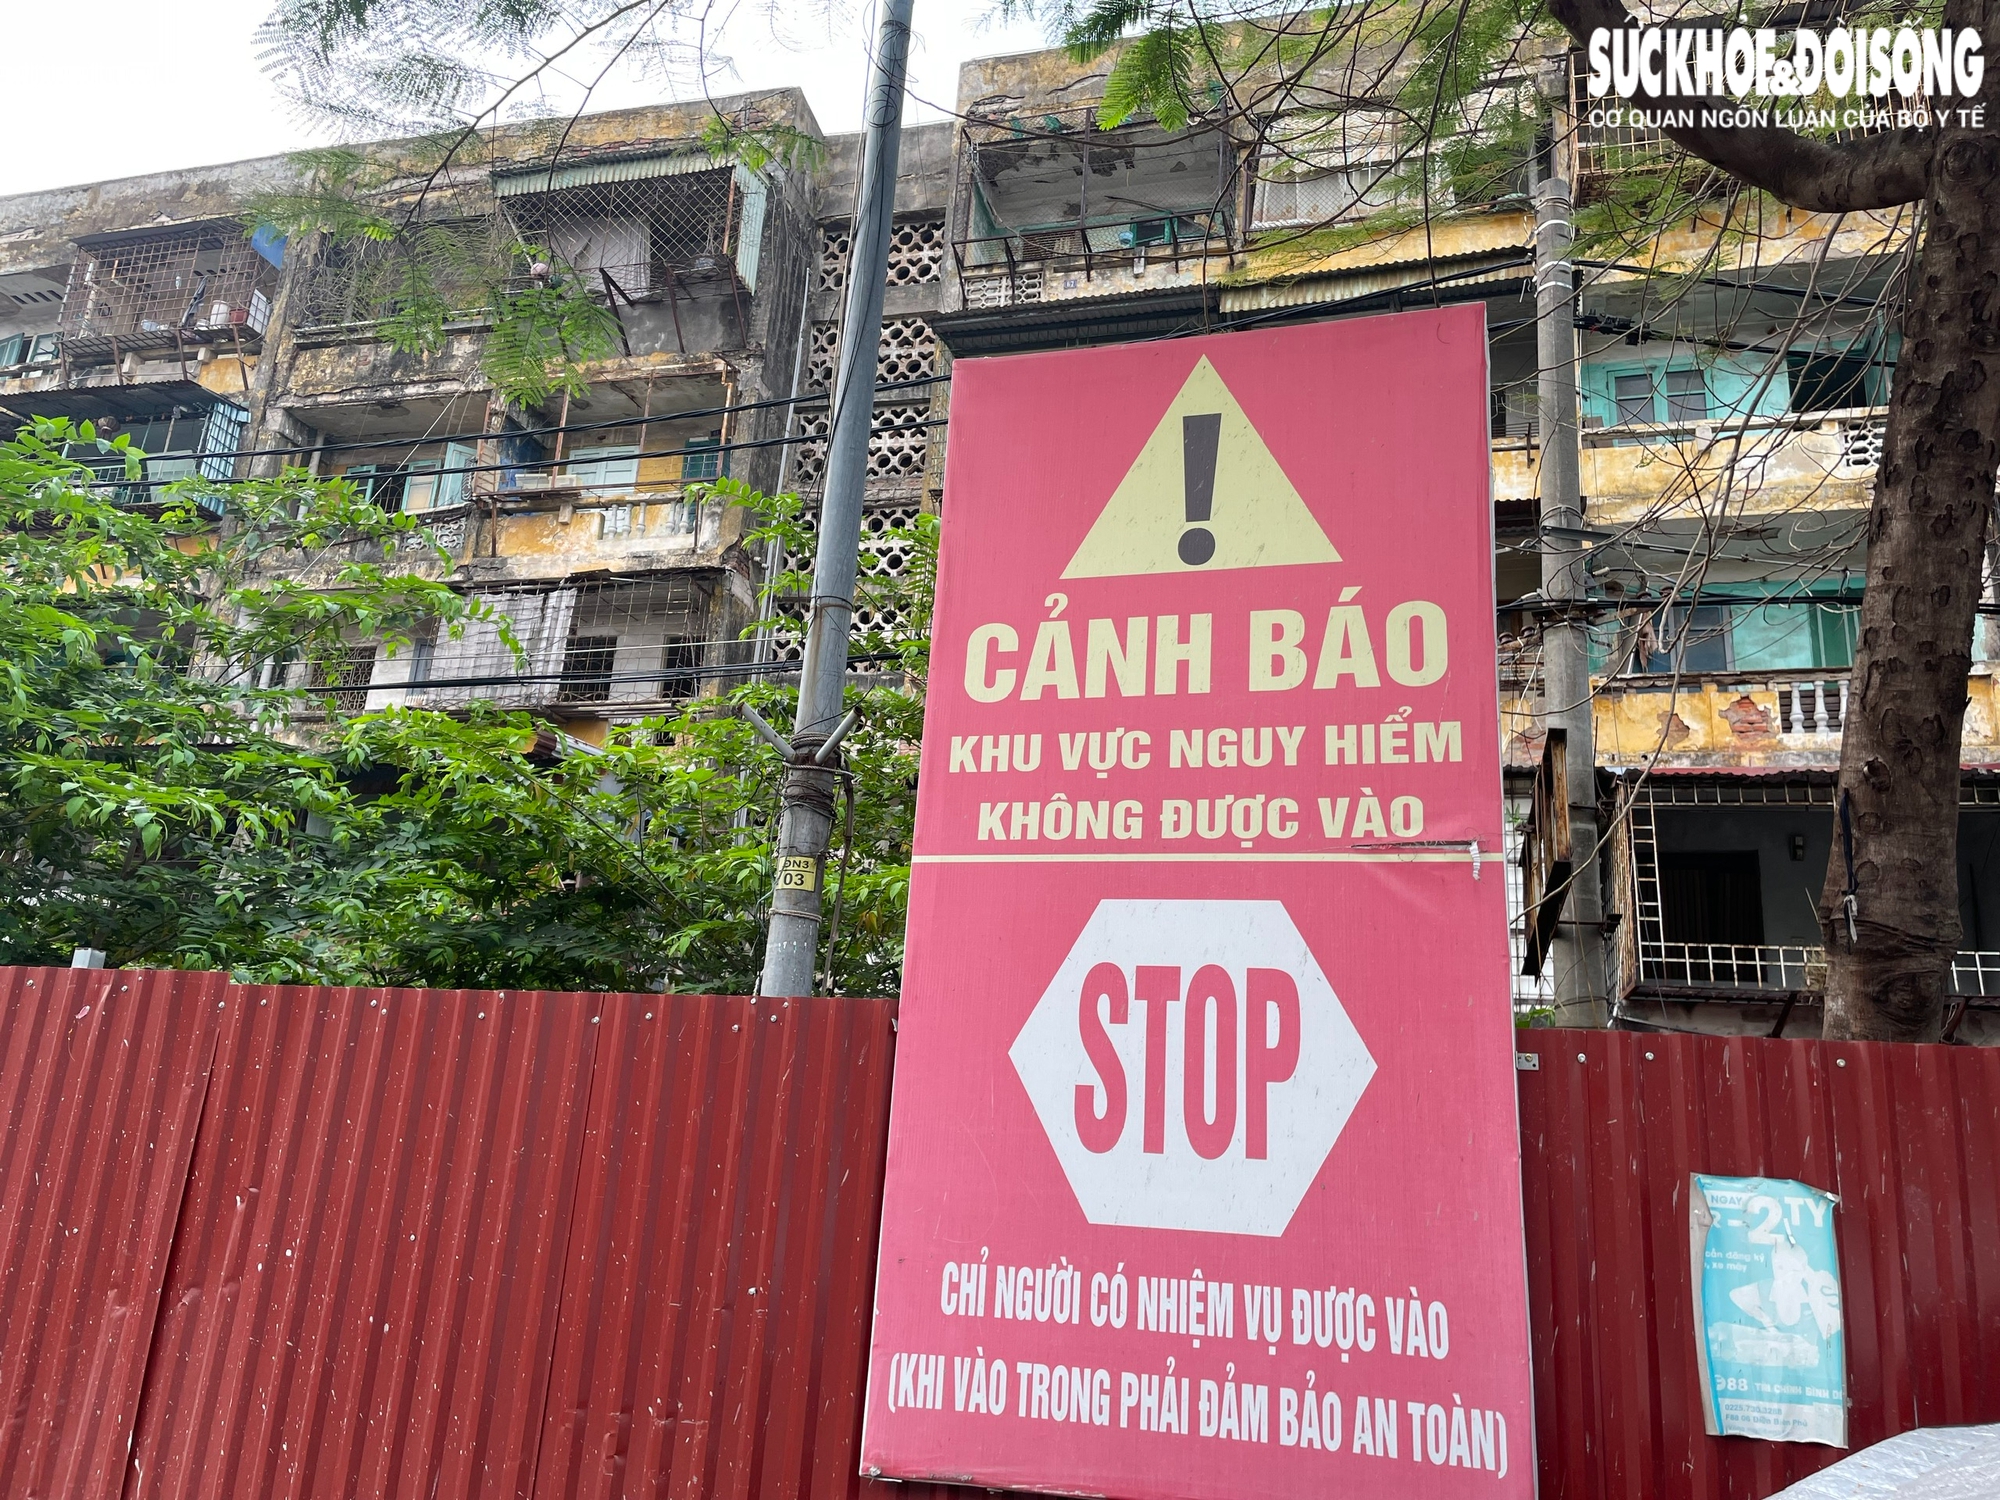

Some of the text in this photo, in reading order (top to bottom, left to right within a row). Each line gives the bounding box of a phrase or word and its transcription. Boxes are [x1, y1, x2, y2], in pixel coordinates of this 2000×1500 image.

[963, 585, 1449, 703] CẢNH BÁO
[949, 706, 1463, 779] KHU VỰC NGUY HIỂM
[977, 787, 1424, 848] KHÔNG ĐƯỢC VÀO
[783, 872, 805, 886] 03
[1074, 962, 1301, 1160] STOP
[1710, 1194, 1743, 1206] NGAY
[940, 1245, 1449, 1364] CHỈ NGƯỜI CÓ NHIỆM VỤ ĐƯỢC VÀO
[887, 1346, 1508, 1479] (KHI VÀO TRONG PHẢI ĐẢM BẢO AN TOÀN)
